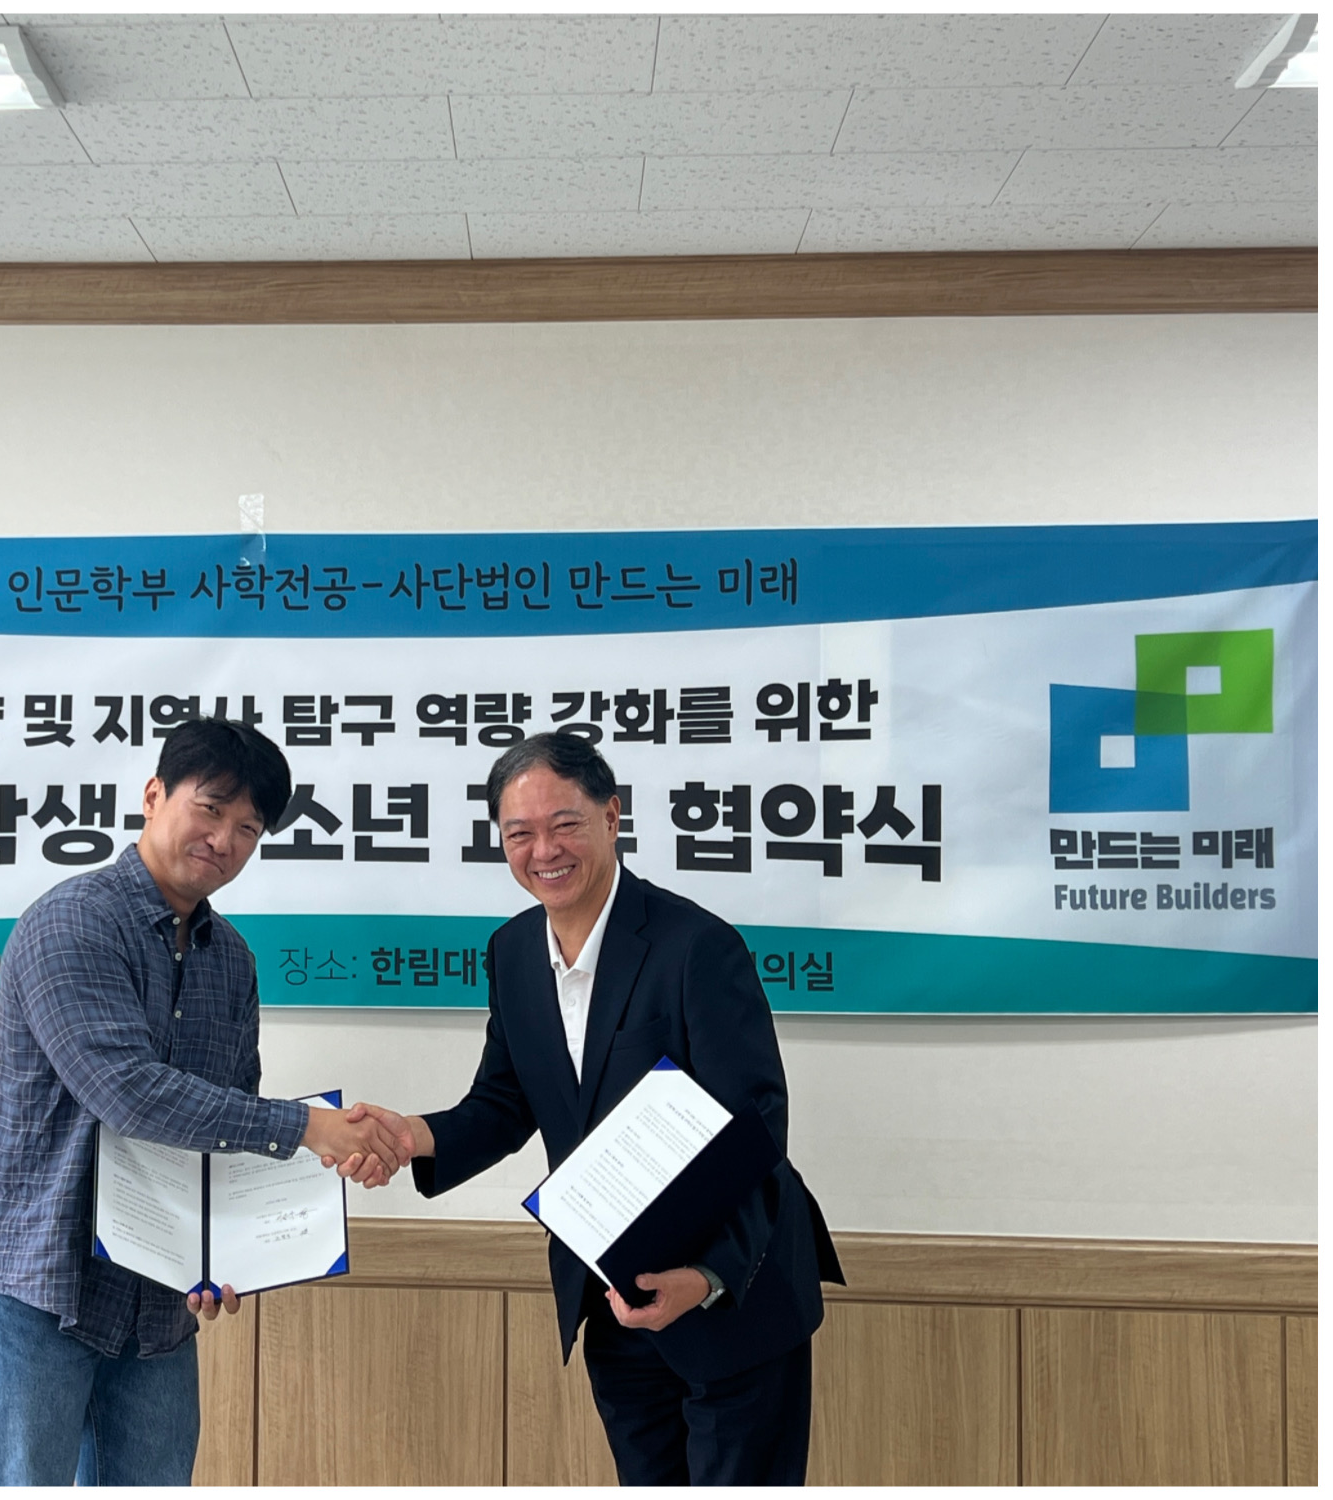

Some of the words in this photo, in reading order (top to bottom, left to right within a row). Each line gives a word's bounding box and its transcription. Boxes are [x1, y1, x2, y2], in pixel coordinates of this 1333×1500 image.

[8, 565, 176, 613] 인문학부
[190, 562, 551, 611] 사학전공-사단법인
[569, 561, 701, 609] 만드는
[718, 557, 799, 606] 미래
[23, 694, 75, 747] 및
[282, 694, 396, 747] 탐구
[416, 692, 532, 748] 역량
[550, 686, 734, 745] 강화를
[755, 678, 879, 742] 위한
[669, 781, 942, 883] 협약식
[1050, 828, 1180, 870] 만드는
[1192, 827, 1274, 869] 미래
[1054, 884, 1148, 910] Future
[1156, 882, 1277, 911] Builders
[279, 947, 357, 986] 장소:
[370, 947, 488, 987] 한림대
[751, 951, 834, 991] 의실
